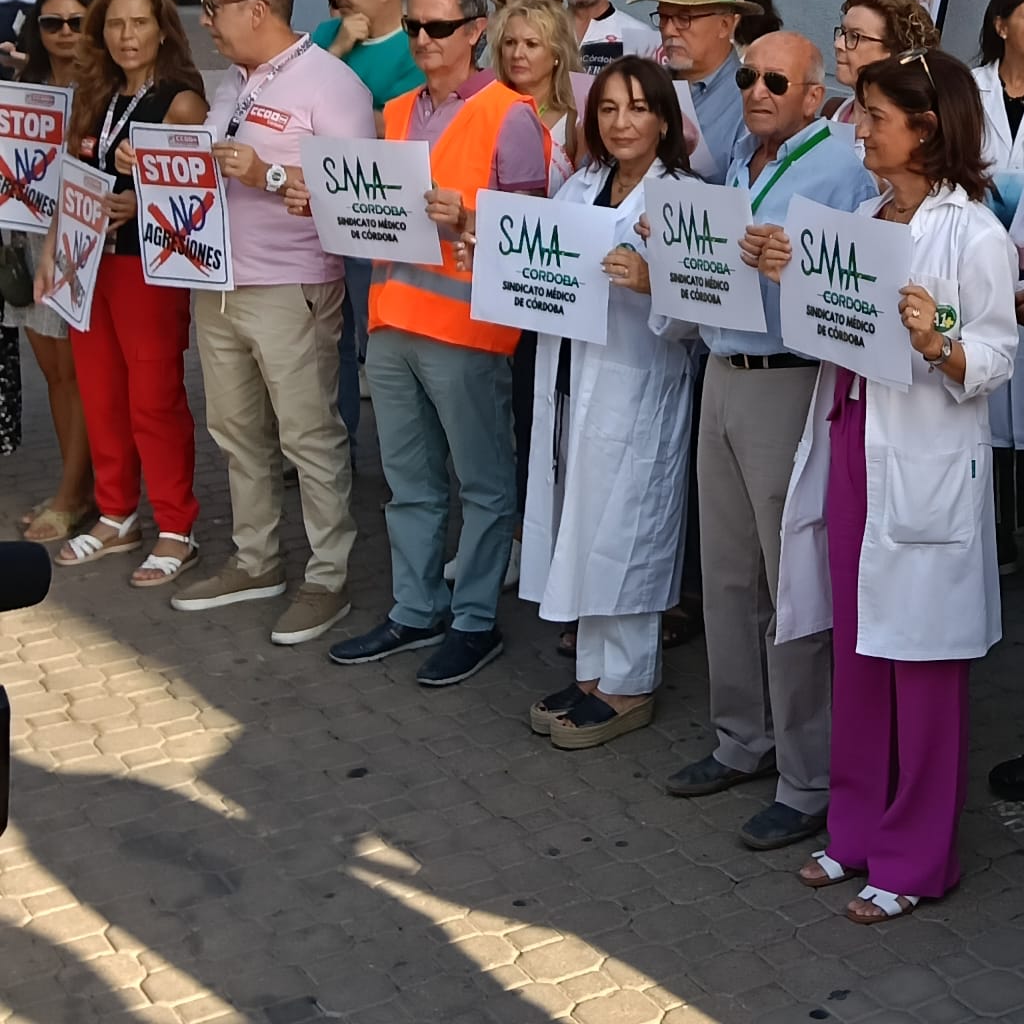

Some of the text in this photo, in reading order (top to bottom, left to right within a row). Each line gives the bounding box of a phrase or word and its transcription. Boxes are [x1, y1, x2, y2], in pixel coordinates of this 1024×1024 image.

[0, 109, 56, 139] STOP
[15, 147, 47, 184] NO
[142, 154, 206, 184] STOP
[323, 155, 402, 201] SMA
[169, 194, 207, 236] NO
[337, 216, 407, 232] SINDICATO MÉDICO
[352, 203, 408, 217] CORDOBA
[351, 230, 399, 244] DE CÓRDOBA
[499, 213, 581, 268] SMA
[662, 200, 728, 256] SMA
[144, 222, 223, 270] AGRESIONES
[683, 257, 732, 277] CORDOBA
[800, 228, 878, 294] SMA
[502, 280, 577, 304] SINDICATO MÉDICO
[522, 267, 580, 289] CORDOBA
[669, 272, 730, 292] SINDICATO MÉDICO
[514, 296, 565, 316] DE CÓRDOBA
[680, 288, 722, 306] DE CÓRDOBA
[823, 290, 879, 318] CORDOBA
[806, 304, 876, 335] SINDICATO MÉDICO
[817, 323, 866, 348] DE CÓRDOBA
